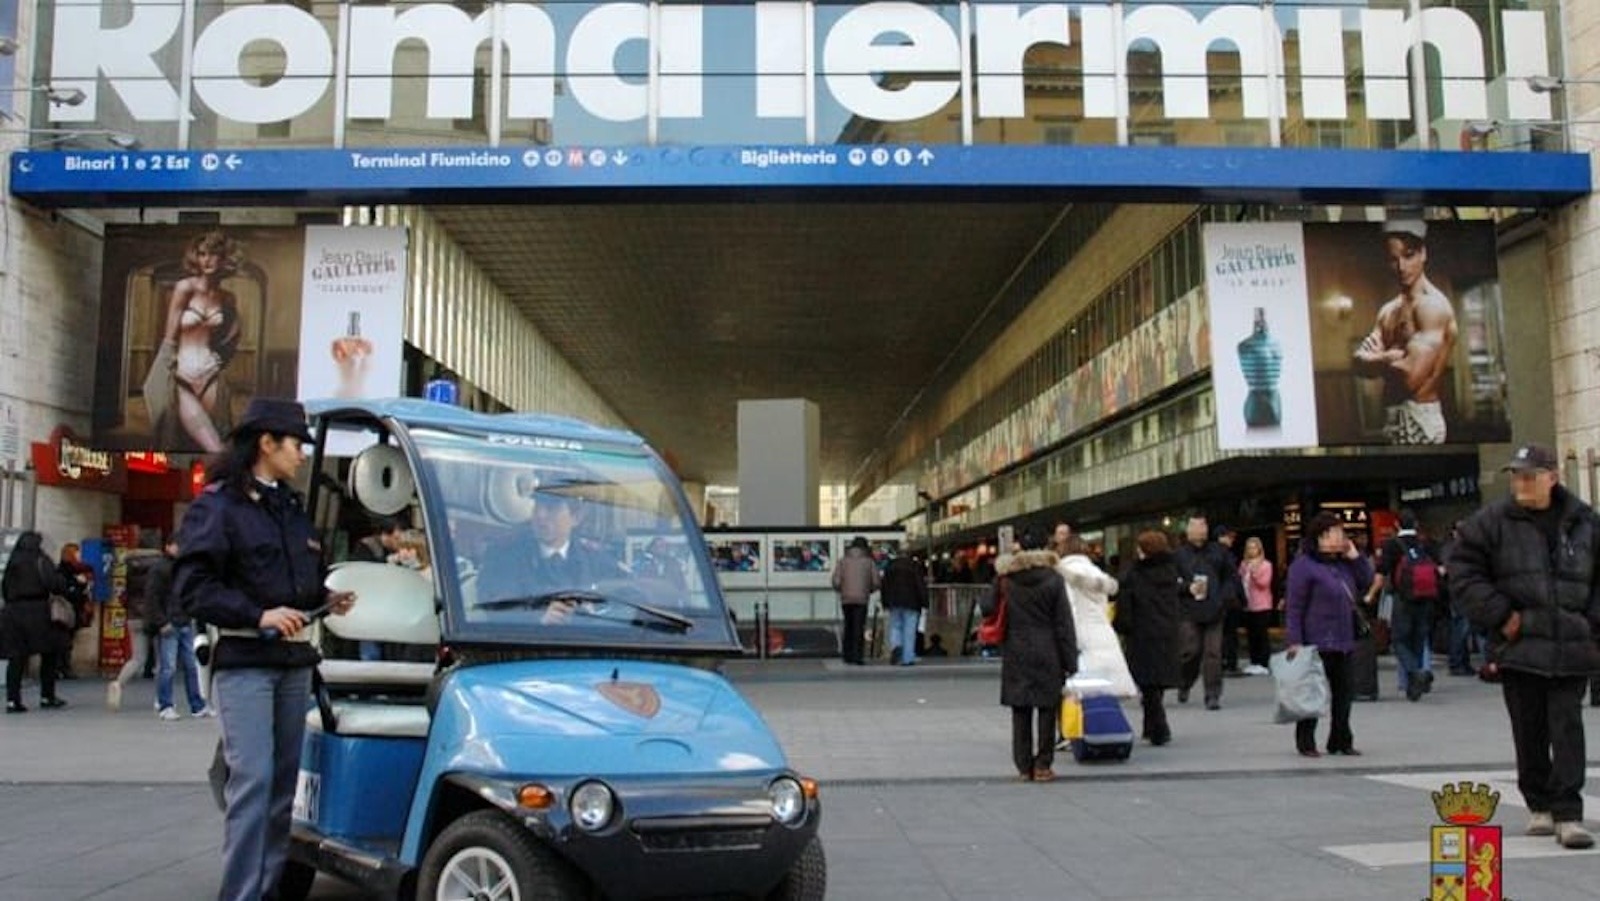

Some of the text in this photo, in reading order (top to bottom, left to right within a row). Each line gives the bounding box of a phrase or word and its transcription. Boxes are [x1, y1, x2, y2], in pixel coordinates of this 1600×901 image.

[48, 0, 703, 122] Roma
[64, 155, 190, 170] Binari 1 e 2 Est
[351, 153, 426, 168] Terminal
[430, 152, 511, 167] Fiumicino
[741, 150, 837, 168] Biglietteria
[312, 257, 396, 280] GAULTIER
[1215, 253, 1296, 275] GAULTIER
